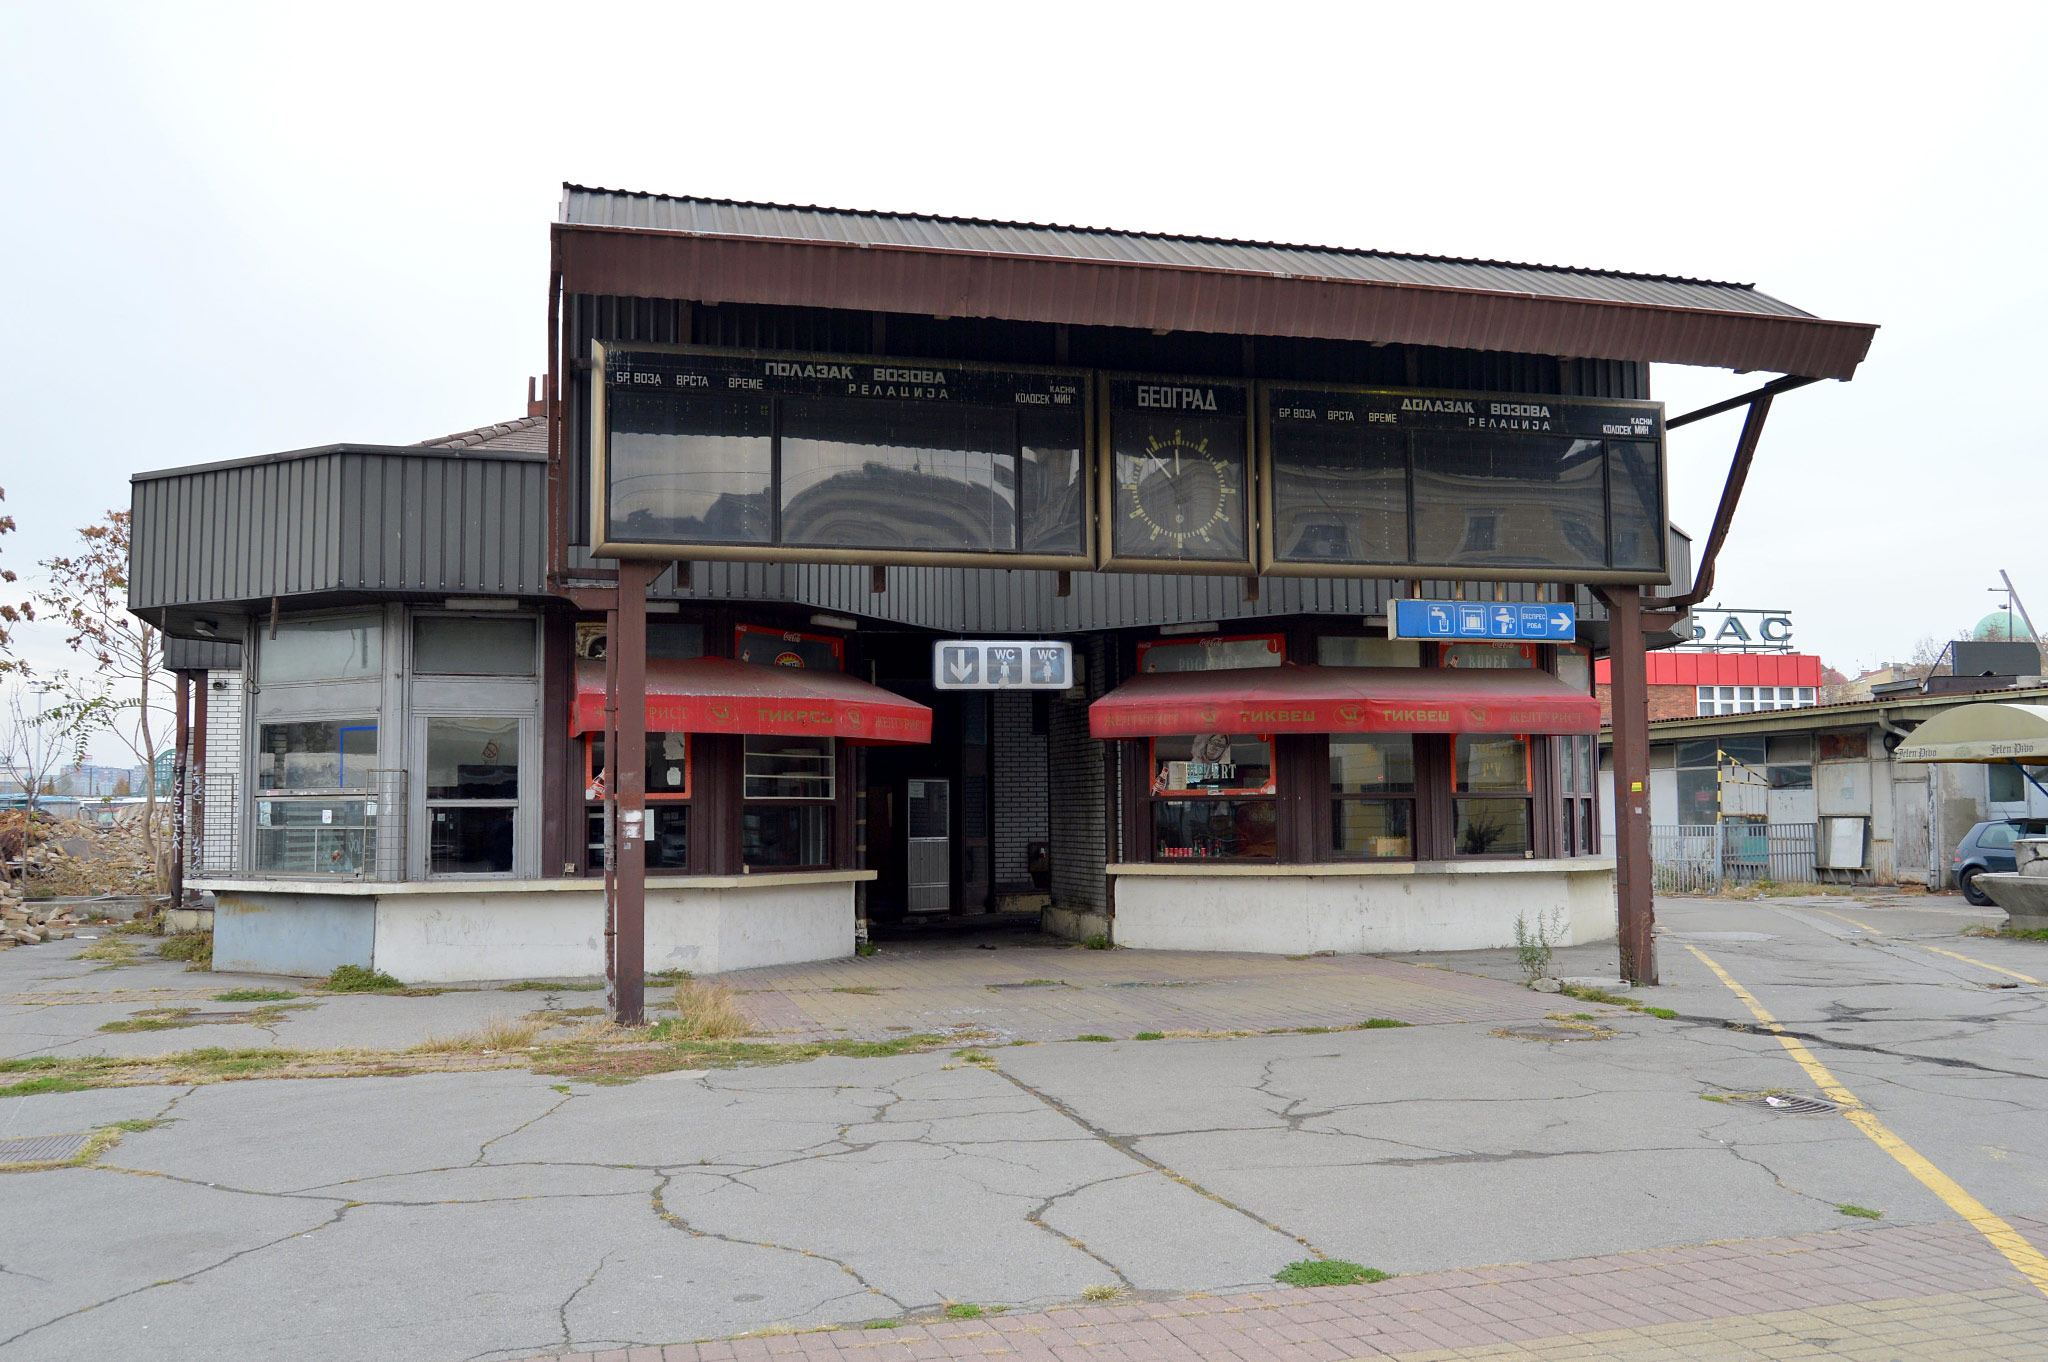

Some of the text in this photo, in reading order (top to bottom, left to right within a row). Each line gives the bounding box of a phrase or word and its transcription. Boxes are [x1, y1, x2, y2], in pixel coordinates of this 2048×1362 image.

[633, 373, 662, 385] ВОЗА
[765, 362, 947, 384] ПОЛАЗАК ВОЗОВА
[676, 374, 709, 387] ВРСТА
[728, 377, 763, 390] ВРЕМЕ
[848, 383, 949, 399] РЕЛАЦИЈА
[1050, 385, 1076, 394] КАСНИ
[1015, 392, 1071, 405] КОЛОСЕК МИН
[1137, 385, 1218, 411] БЕОГРАД
[1293, 408, 1317, 420] ВОЗА
[1401, 398, 1550, 418] ДОЛАЗАК ВОЗОВА
[1327, 410, 1355, 421] ВРСТА
[1368, 412, 1397, 423] ВРЕМЕ
[1630, 417, 1653, 426] КАСНИ
[1468, 417, 1551, 431] РЕЛАЦИЈА
[1602, 424, 1649, 435] КОЛОСЕК МИН
[994, 649, 1058, 661] WC WC
[1239, 709, 1316, 723] ТИКВЕШ
[1382, 709, 1450, 722] ТИКВЕШ
[1898, 747, 1937, 760] Jelen Pivo
[1989, 742, 2034, 756] Jelen Pivo
